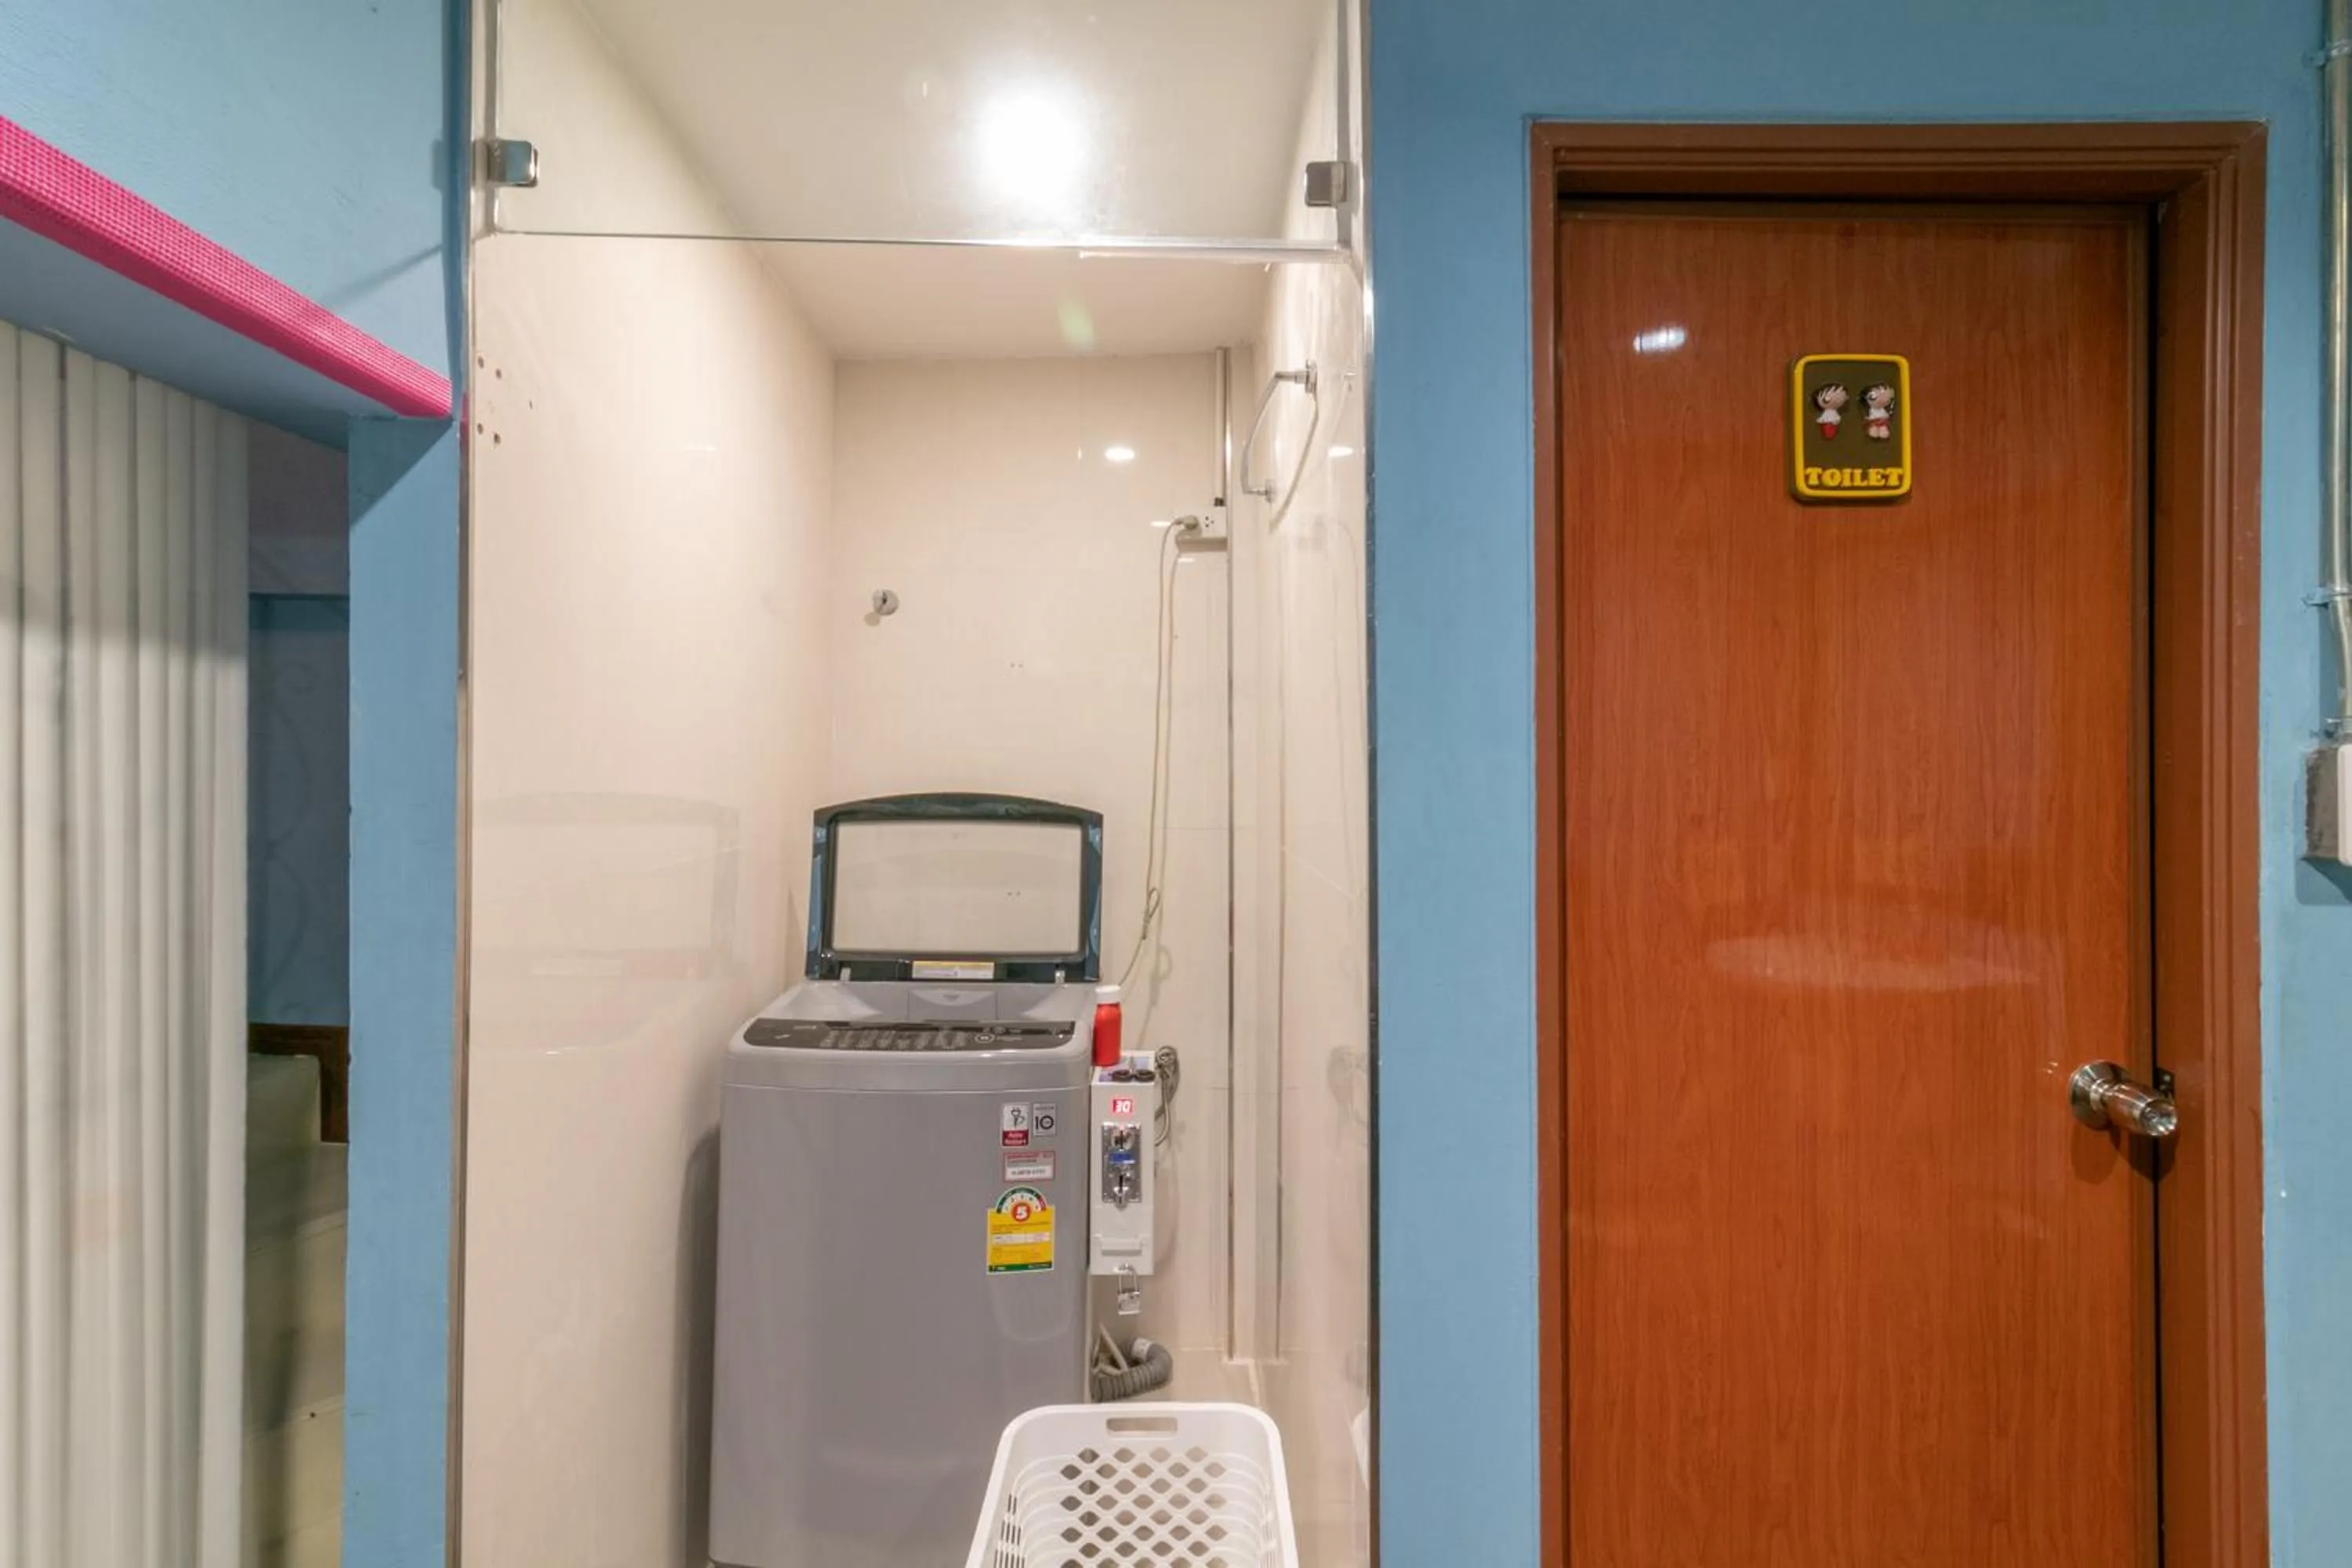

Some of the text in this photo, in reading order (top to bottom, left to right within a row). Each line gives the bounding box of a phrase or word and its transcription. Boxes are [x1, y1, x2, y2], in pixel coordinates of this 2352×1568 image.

[1806, 466, 1903, 487] TOILET
[1116, 1099, 1131, 1113] 30
[1015, 1206, 1029, 1219] 5
